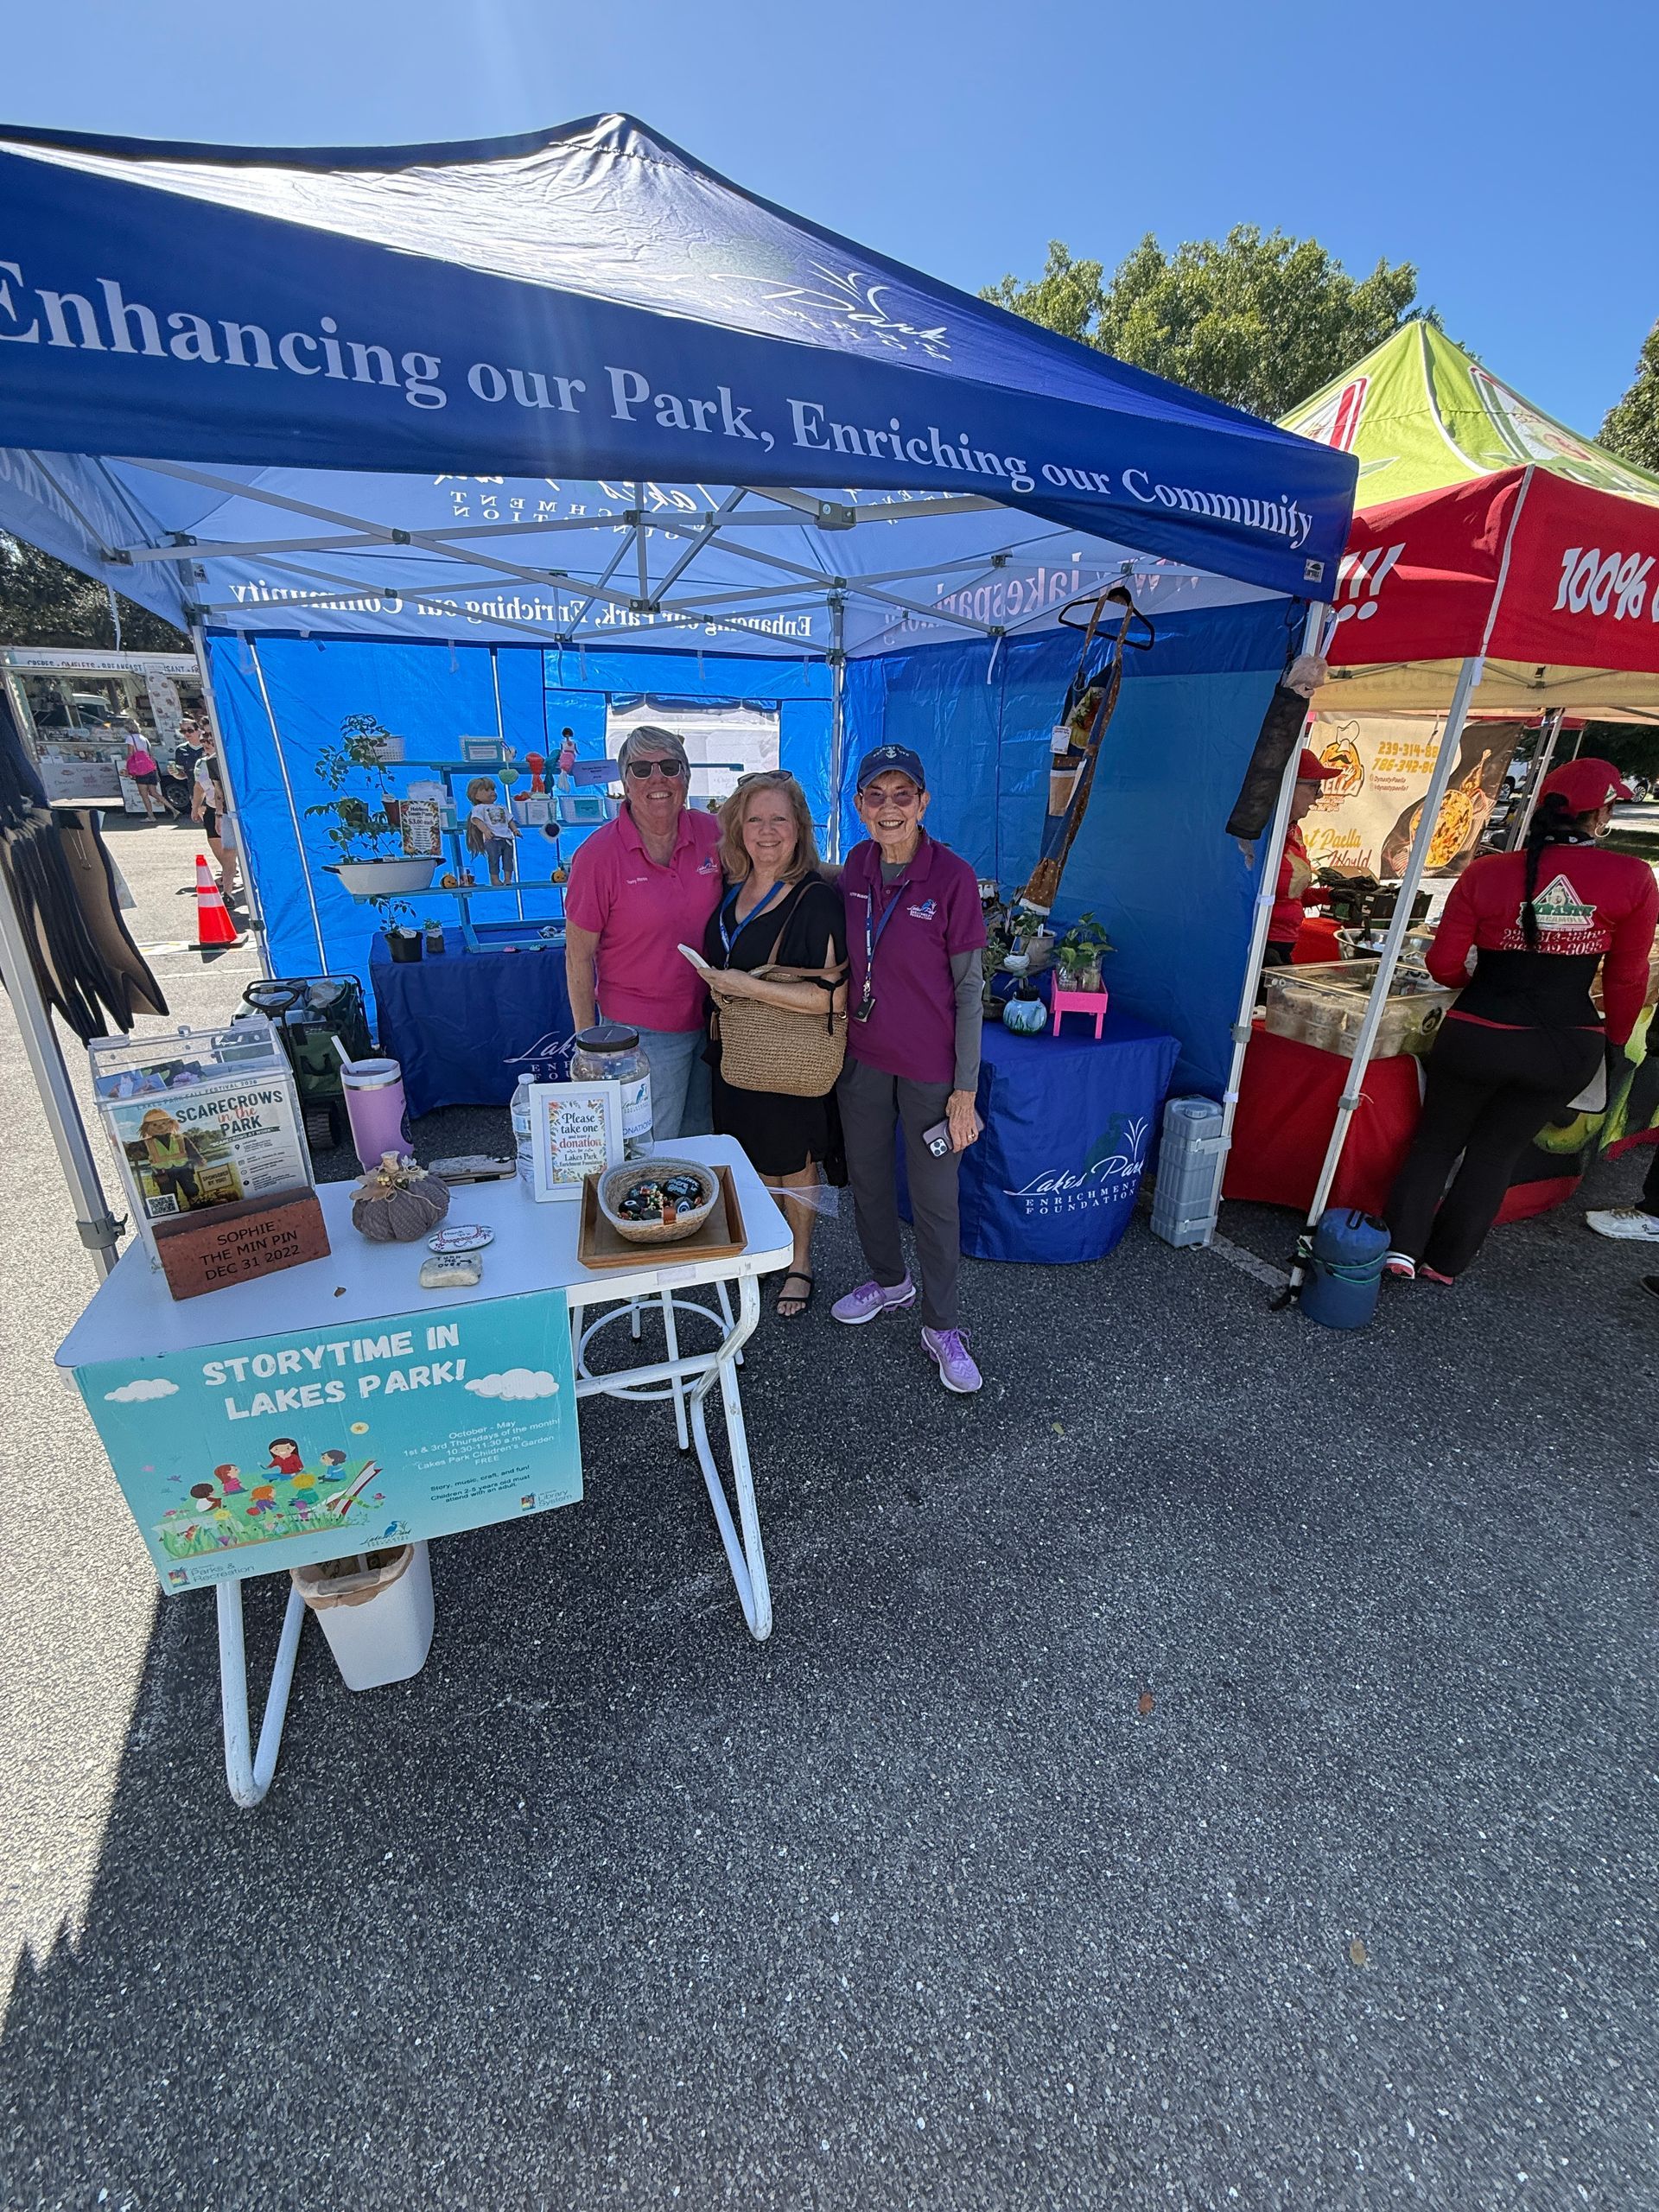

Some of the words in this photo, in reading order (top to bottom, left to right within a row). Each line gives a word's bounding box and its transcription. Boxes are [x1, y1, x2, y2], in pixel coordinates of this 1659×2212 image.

[467, 361, 587, 413] our
[605, 365, 775, 453] Park,
[785, 397, 1036, 493] Enriching
[1042, 462, 1110, 495] our
[1122, 467, 1313, 549] Community
[1552, 547, 1656, 621] 100%
[1378, 741, 1440, 758] 239-314-88
[1371, 758, 1436, 774] 786-342-80
[1320, 829, 1362, 849] Paella
[175, 1090, 283, 1124] SCARECROWS
[234, 1105, 257, 1120] the
[562, 1113, 595, 1124] Please
[220, 1116, 263, 1136] PARK
[561, 1123, 581, 1135] take
[559, 1138, 602, 1148] donation
[1003, 1169, 1087, 1196] Lakes
[1090, 1154, 1146, 1183] Park
[1026, 1179, 1137, 1207] ENRICHMENT
[1026, 1188, 1136, 1215] FOUNDATION
[217, 1221, 276, 1246] SOPHIE
[200, 1248, 232, 1266] THE
[238, 1237, 267, 1255] MIN
[272, 1230, 298, 1246] PIN
[205, 1262, 238, 1281] DEC
[242, 1256, 260, 1270] 31
[265, 1244, 301, 1263] 2022
[202, 1331, 414, 1386] STORYTIME
[426, 1323, 460, 1351] IN
[224, 1380, 346, 1421] LAKES
[358, 1358, 467, 1399] PARK!
[431, 1443, 448, 1452] 3rd
[450, 1433, 499, 1448] Thursdays
[502, 1428, 512, 1437] of
[530, 1418, 561, 1431] month!
[448, 1426, 488, 1440] October
[497, 1420, 517, 1430] May
[417, 1459, 447, 1471] Lakes
[448, 1454, 471, 1465] Park
[473, 1443, 519, 1459] Children's
[521, 1434, 555, 1448] Garden
[475, 1455, 500, 1466] FREE
[430, 1483, 454, 1493] Story,
[480, 1471, 499, 1482] craft,
[500, 1468, 515, 1477] and
[430, 1491, 463, 1502] Children
[478, 1482, 499, 1492] years
[500, 1478, 512, 1486] old
[513, 1474, 531, 1483] must
[445, 1494, 469, 1503] attend
[470, 1490, 486, 1498] with
[498, 1482, 518, 1491] adult.
[537, 1490, 569, 1502] Library
[539, 1494, 573, 1507] System
[191, 1566, 224, 1577] Parks
[193, 1566, 255, 1583] Recreation
